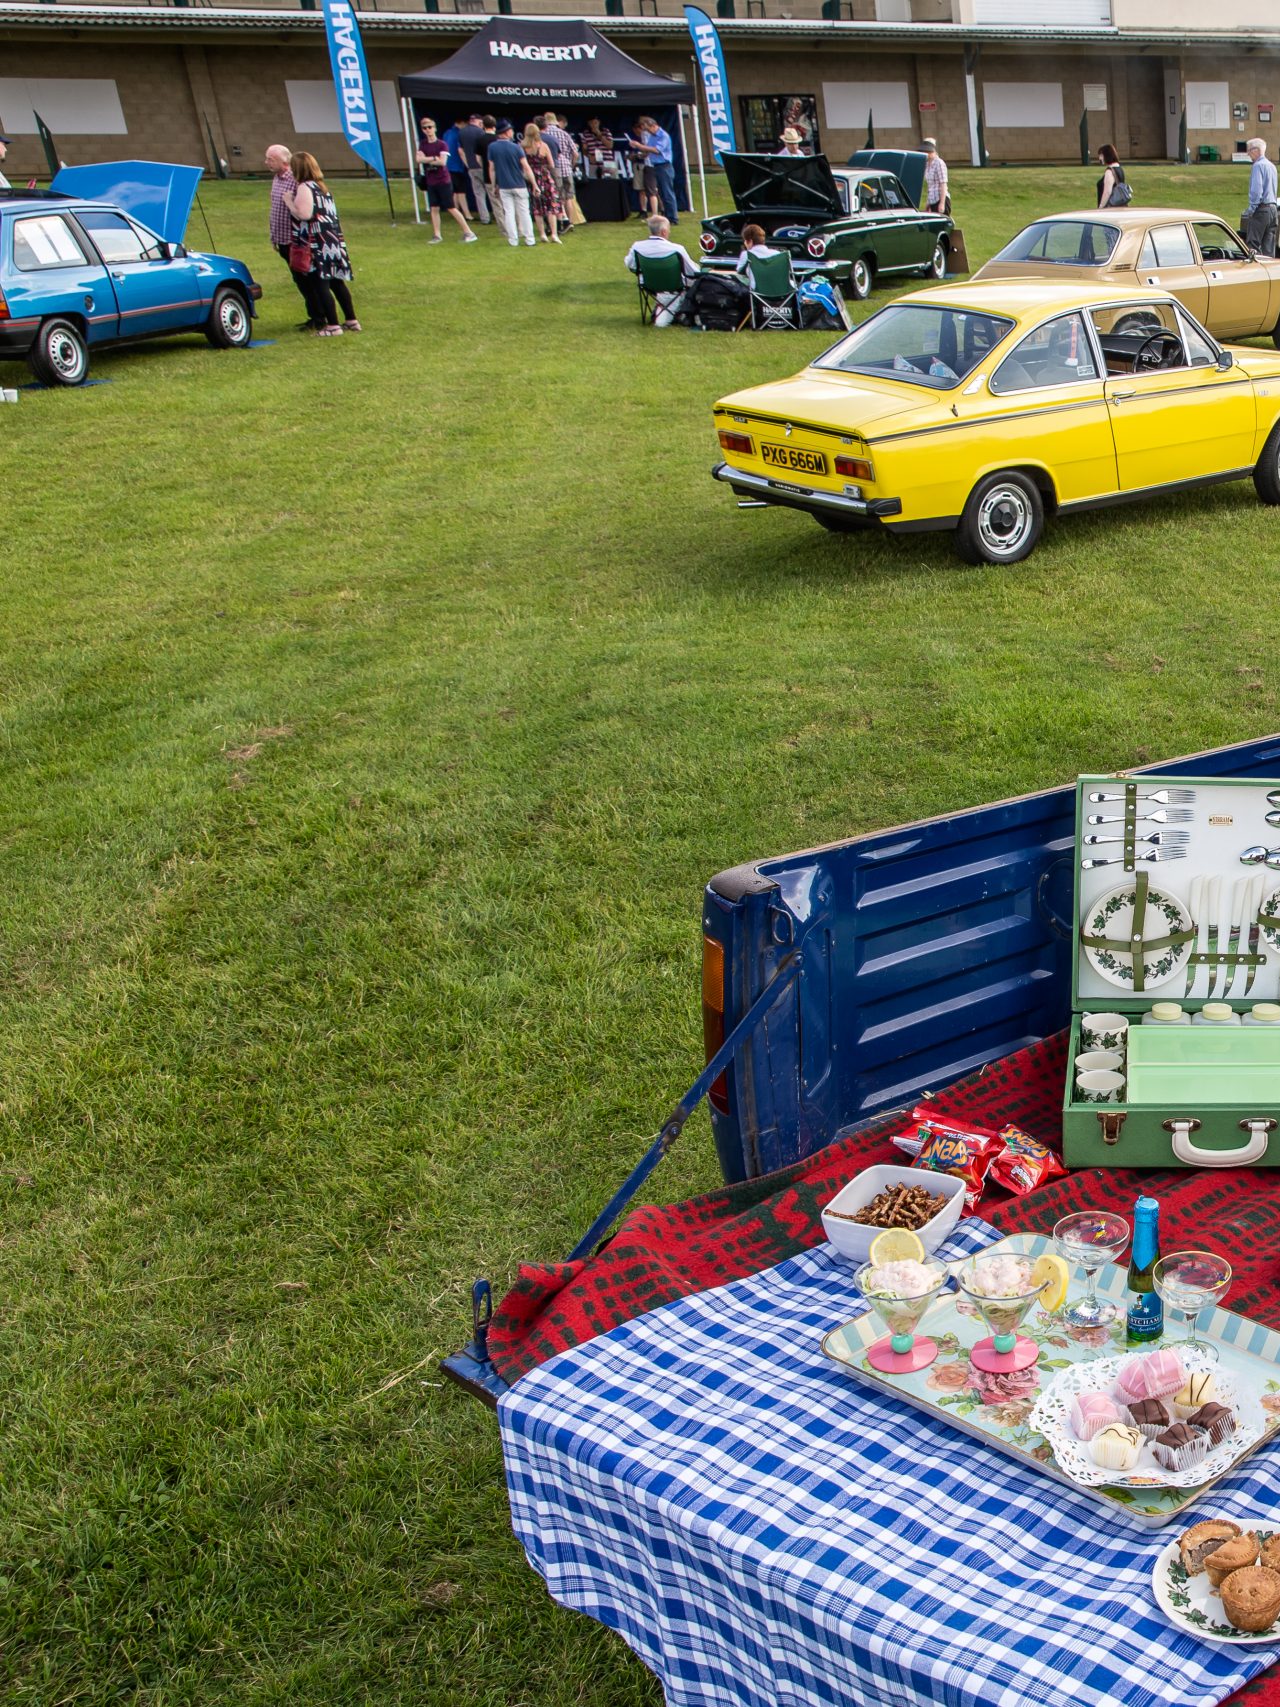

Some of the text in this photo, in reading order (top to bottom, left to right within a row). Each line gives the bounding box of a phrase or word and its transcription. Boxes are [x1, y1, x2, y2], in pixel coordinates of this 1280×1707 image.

[489, 40, 598, 61] HAGERTY
[486, 86, 617, 99] CLASSIC CAR & BIKE INSURANCE
[761, 445, 825, 473] PXG 666M
